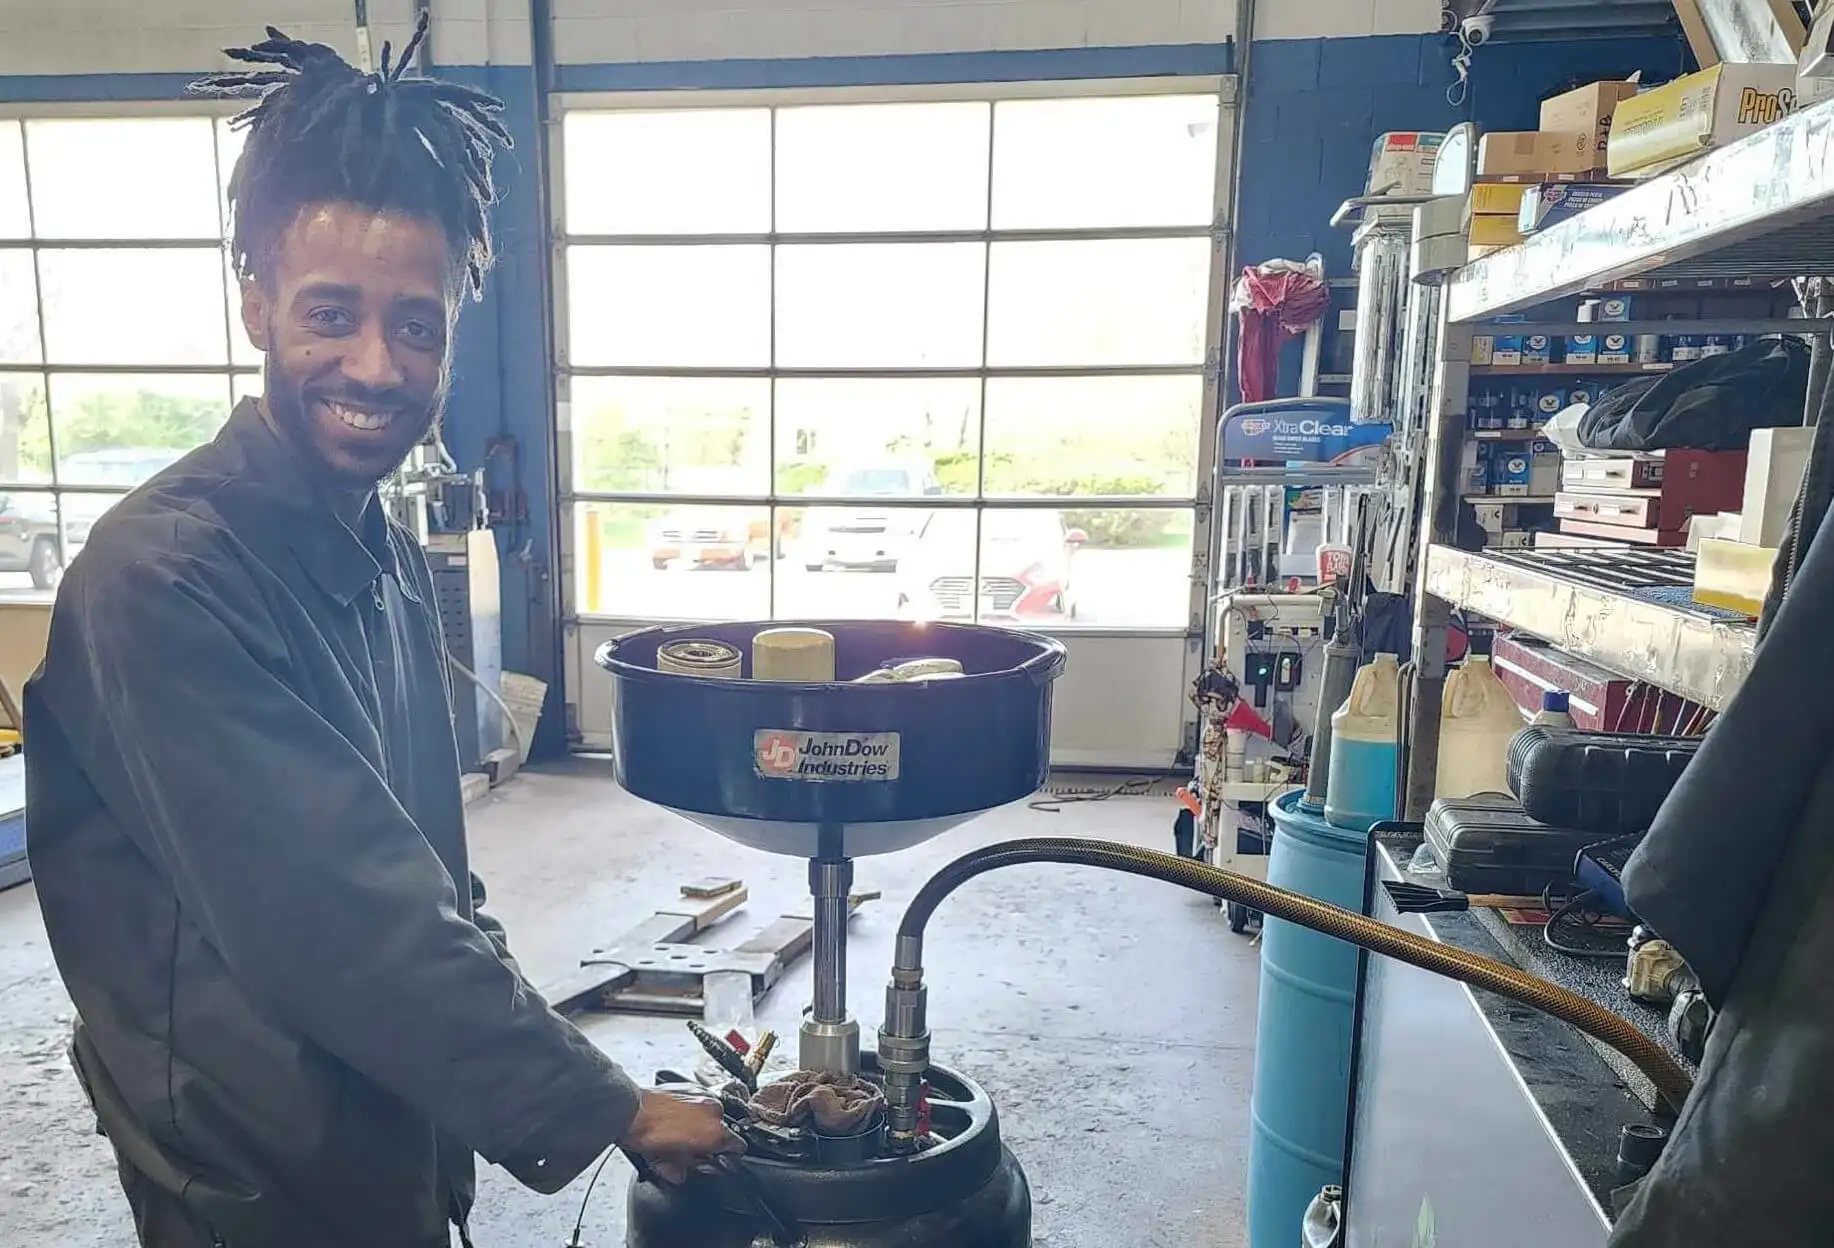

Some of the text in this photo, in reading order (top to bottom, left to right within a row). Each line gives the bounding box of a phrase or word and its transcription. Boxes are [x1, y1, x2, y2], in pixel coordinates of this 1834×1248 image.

[762, 738, 795, 768] JD
[799, 737, 889, 757] JohnDow
[798, 758, 888, 776] Industries
